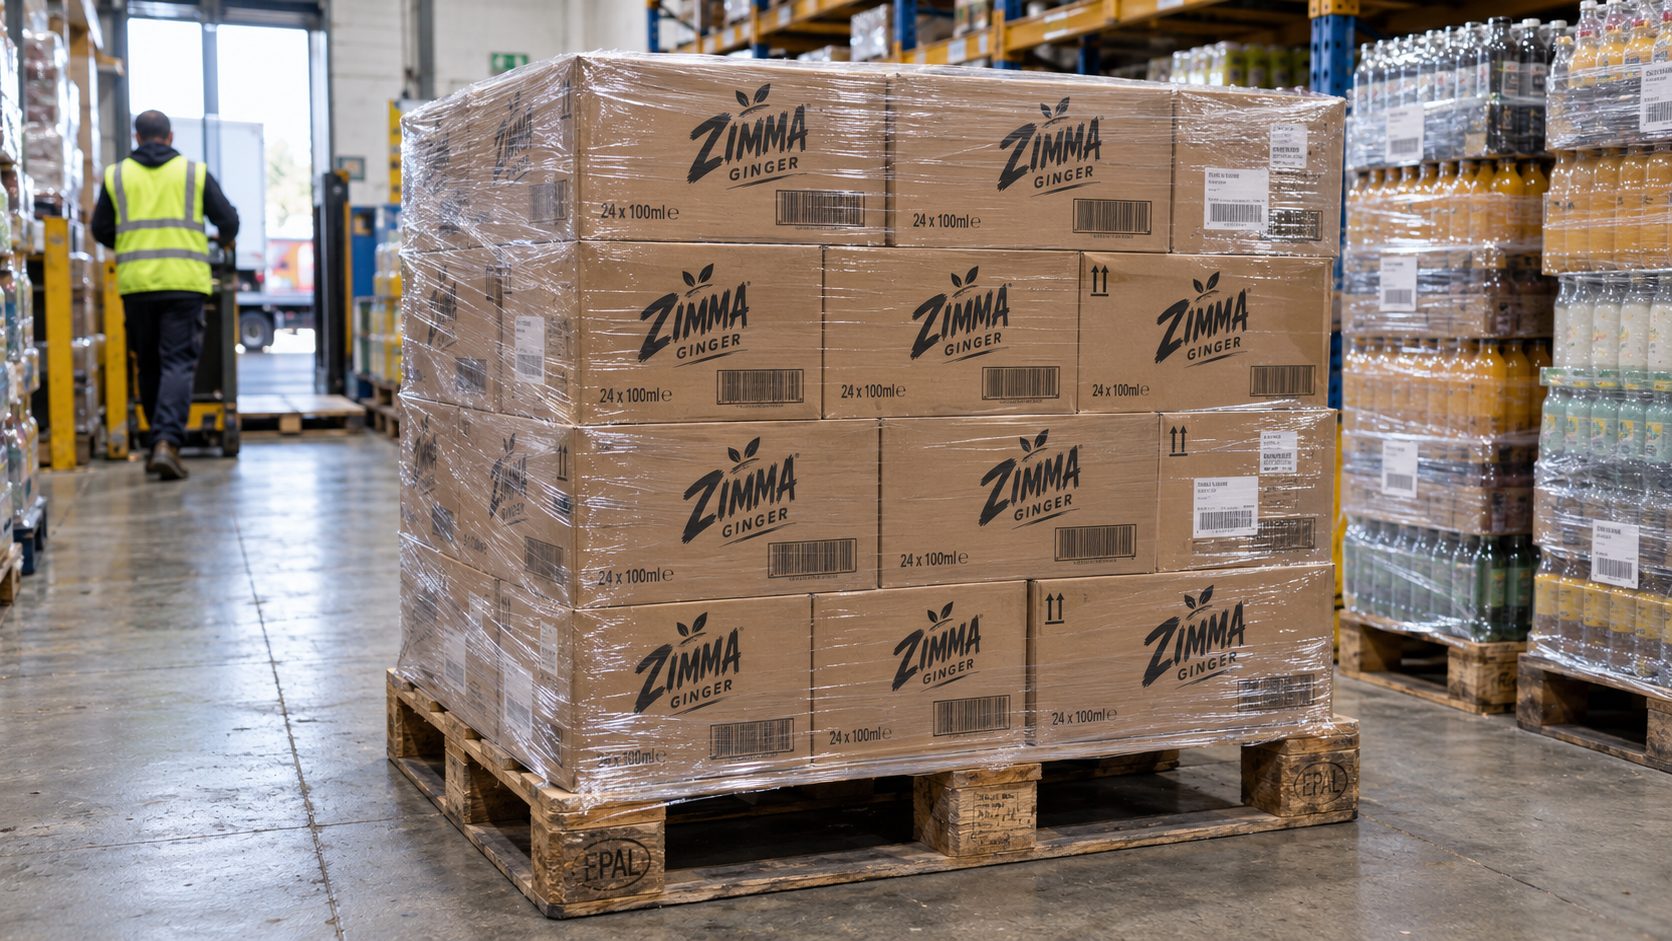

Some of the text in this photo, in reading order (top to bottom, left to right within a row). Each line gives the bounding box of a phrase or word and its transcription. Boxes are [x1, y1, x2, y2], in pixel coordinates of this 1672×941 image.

[687, 104, 808, 184] ZIMMA
[997, 116, 1102, 192] ZIMMA
[729, 157, 799, 181] GINGER
[1034, 166, 1093, 189] GINGER
[601, 203, 616, 219] 24
[620, 207, 625, 218] x
[913, 213, 926, 228] 24
[929, 216, 935, 227] x
[638, 282, 749, 363] ZIMMA
[910, 283, 1010, 360] ZIMMA
[1154, 288, 1249, 364] ZIMMA
[676, 334, 741, 360] GINGER
[944, 332, 1002, 356] GINGER
[1187, 336, 1241, 360] GINGER
[600, 388, 613, 403] 24
[617, 391, 623, 403] x
[841, 385, 854, 398] 24
[856, 388, 862, 398] x
[1092, 384, 1104, 397] 24
[1106, 386, 1111, 397] x
[681, 454, 797, 544] ZIMMA
[978, 445, 1080, 527] ZIMMA
[1014, 494, 1072, 521] GINGER
[722, 508, 788, 538] GINGER
[900, 554, 913, 568] 24
[916, 556, 922, 567] x
[598, 570, 612, 585] 24
[616, 573, 622, 584] x
[892, 614, 981, 691] ZIMMA
[1142, 601, 1246, 688] ZIMMA
[634, 628, 741, 714] ZIMMA
[922, 658, 974, 684] GINGER
[1178, 652, 1237, 681] GINGER
[670, 679, 732, 709] GINGER
[1052, 712, 1064, 726] 24
[1067, 714, 1073, 724] x
[829, 730, 842, 745] 24
[844, 732, 850, 743] x
[1302, 770, 1340, 796] EPAL
[585, 848, 641, 881] EPAL
